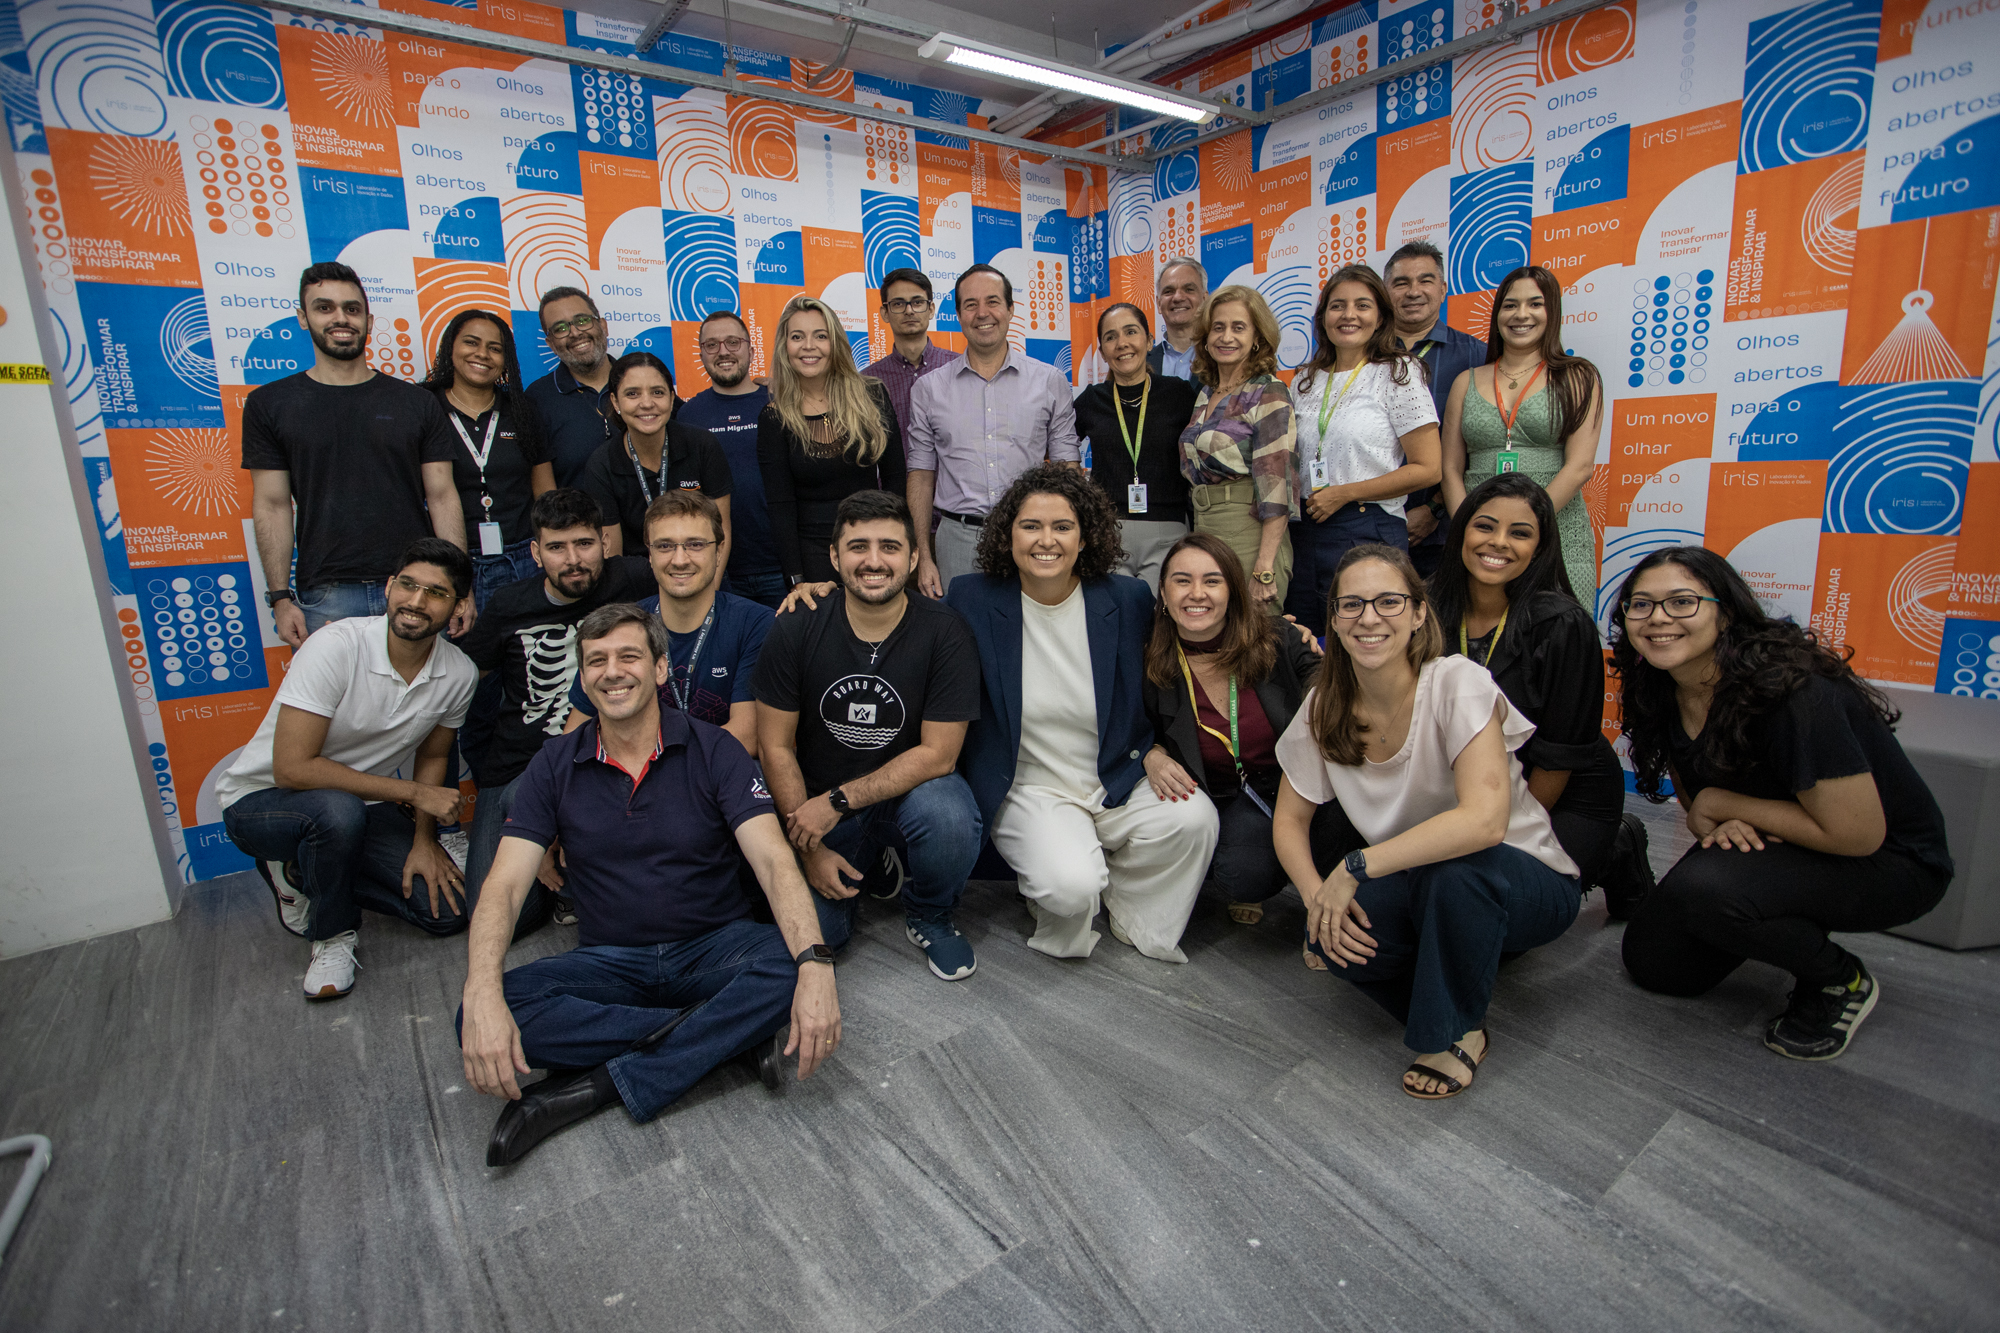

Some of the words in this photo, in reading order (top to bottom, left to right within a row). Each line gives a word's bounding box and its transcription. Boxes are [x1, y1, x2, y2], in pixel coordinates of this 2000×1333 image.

[596, 29, 628, 41] Inspirar
[398, 40, 446, 58] olhar
[403, 71, 445, 87] para
[450, 79, 461, 89] o
[1892, 60, 1974, 94] Olhos
[496, 77, 544, 96] Olhos
[1547, 87, 1598, 111] Olhos
[407, 101, 470, 120] mundo
[500, 106, 565, 127] abertos
[1319, 101, 1353, 120] Olhos
[1887, 92, 2000, 132] abertos
[291, 123, 340, 138] INOVAR,
[1319, 122, 1368, 146] abertos
[1546, 111, 1618, 141] abertos
[292, 132, 385, 152] TRANSFORMAR
[294, 142, 303, 151] &
[306, 143, 363, 158] INSPIRAR
[503, 133, 540, 152] para
[546, 141, 556, 153] o
[1272, 140, 1291, 150] Inovar
[1272, 142, 1310, 158] Transformar
[411, 142, 463, 162] Olhos
[923, 152, 941, 163] Um
[943, 156, 968, 168] novo
[1272, 153, 1296, 165] Inspirar
[1544, 150, 1585, 173] para
[1589, 147, 1602, 159] o
[1883, 143, 1946, 173] para
[1955, 138, 1974, 154] o
[974, 142, 982, 196] TRANSFORMA
[1319, 155, 1346, 172] para
[1350, 151, 1358, 161] o
[505, 162, 559, 181] futuro
[1025, 171, 1051, 185] Olhos
[415, 172, 486, 193] abertos
[925, 174, 952, 186] olhar
[1260, 181, 1278, 193] Um
[1280, 171, 1308, 187] novo
[1319, 176, 1358, 194] futuro
[741, 187, 778, 202] Olhos
[1544, 177, 1602, 200] futuro
[1879, 177, 1970, 207] futuro
[925, 194, 949, 206] para
[951, 199, 958, 209] o
[1027, 193, 1061, 206] abertos
[418, 202, 460, 219] para
[465, 208, 476, 219] o
[1200, 201, 1245, 219] TRANSFORMAR
[1260, 200, 1289, 216] olhar
[743, 213, 793, 228] abertos
[926, 217, 962, 230] mundo
[1027, 213, 1048, 224] para
[1049, 216, 1055, 225] o
[1205, 211, 1233, 225] INSPIRAR
[1401, 217, 1425, 228] Inovar
[1260, 224, 1285, 240] para
[1288, 223, 1295, 232] o
[1401, 221, 1449, 237] Transformar
[1543, 227, 1572, 243] Um
[1577, 217, 1621, 237] novo
[1661, 225, 1695, 238] Inovar
[67, 237, 127, 250] INOVAR,
[422, 230, 480, 248] futuro
[745, 236, 774, 250] para
[776, 240, 786, 250] o
[1028, 232, 1057, 244] futuro
[1660, 230, 1730, 249] Transformar
[69, 247, 182, 263] TRANSFORMAR
[616, 247, 641, 256] Inovar
[927, 247, 957, 260] Olhos
[1261, 245, 1299, 261] mundo
[1659, 246, 1702, 259] Inspirar
[1738, 208, 1757, 306] TRANSFORMAR
[71, 257, 82, 266] &
[85, 257, 155, 271] INSPIRAR
[617, 256, 665, 266] Transformar
[617, 264, 648, 272] Inspirar
[746, 260, 787, 274] futuro
[1541, 253, 1587, 271] olhar
[1751, 231, 1767, 291] INSPIRAR
[214, 262, 276, 278] Olhos
[929, 269, 962, 281] aberto
[1584, 282, 1595, 293] o
[1727, 257, 1743, 307] INOVAR,
[601, 284, 643, 297] Olhos
[1750, 293, 1761, 304] &
[220, 294, 301, 310] abertos
[604, 311, 661, 323] abertos
[226, 326, 273, 340] para
[280, 330, 292, 340] o
[607, 337, 640, 348] para
[643, 338, 653, 348] o
[756, 326, 766, 368] INSPIRAR
[1736, 332, 1800, 351] Olhos
[97, 318, 122, 413] TRANSFORMAR
[230, 356, 298, 370] futuro
[115, 343, 136, 401] INSPIRAR
[1734, 364, 1824, 384] abertos
[94, 364, 113, 413] INOVAR,
[127, 404, 138, 413] &
[1730, 400, 1780, 418] para
[1788, 399, 1801, 413] o
[1626, 412, 1656, 427] Um
[1661, 410, 1709, 425] novo
[727, 423, 758, 431] Migratio
[1728, 432, 1799, 446] futuro
[1623, 441, 1672, 456] olhar
[680, 480, 700, 488] aws
[1621, 472, 1666, 487] para
[1669, 472, 1681, 484] o
[1619, 499, 1684, 514] mundo
[124, 525, 179, 536] INOVAR,
[124, 531, 228, 545] TRANSFORMAR
[127, 545, 138, 554] &
[140, 541, 205, 553] INSPIRAR
[1740, 570, 1777, 579] Inovar
[1948, 592, 1959, 602] &
[1833, 592, 1851, 649] INSPIRAR
[833, 679, 869, 700] BOARD
[873, 682, 895, 705] WAY
